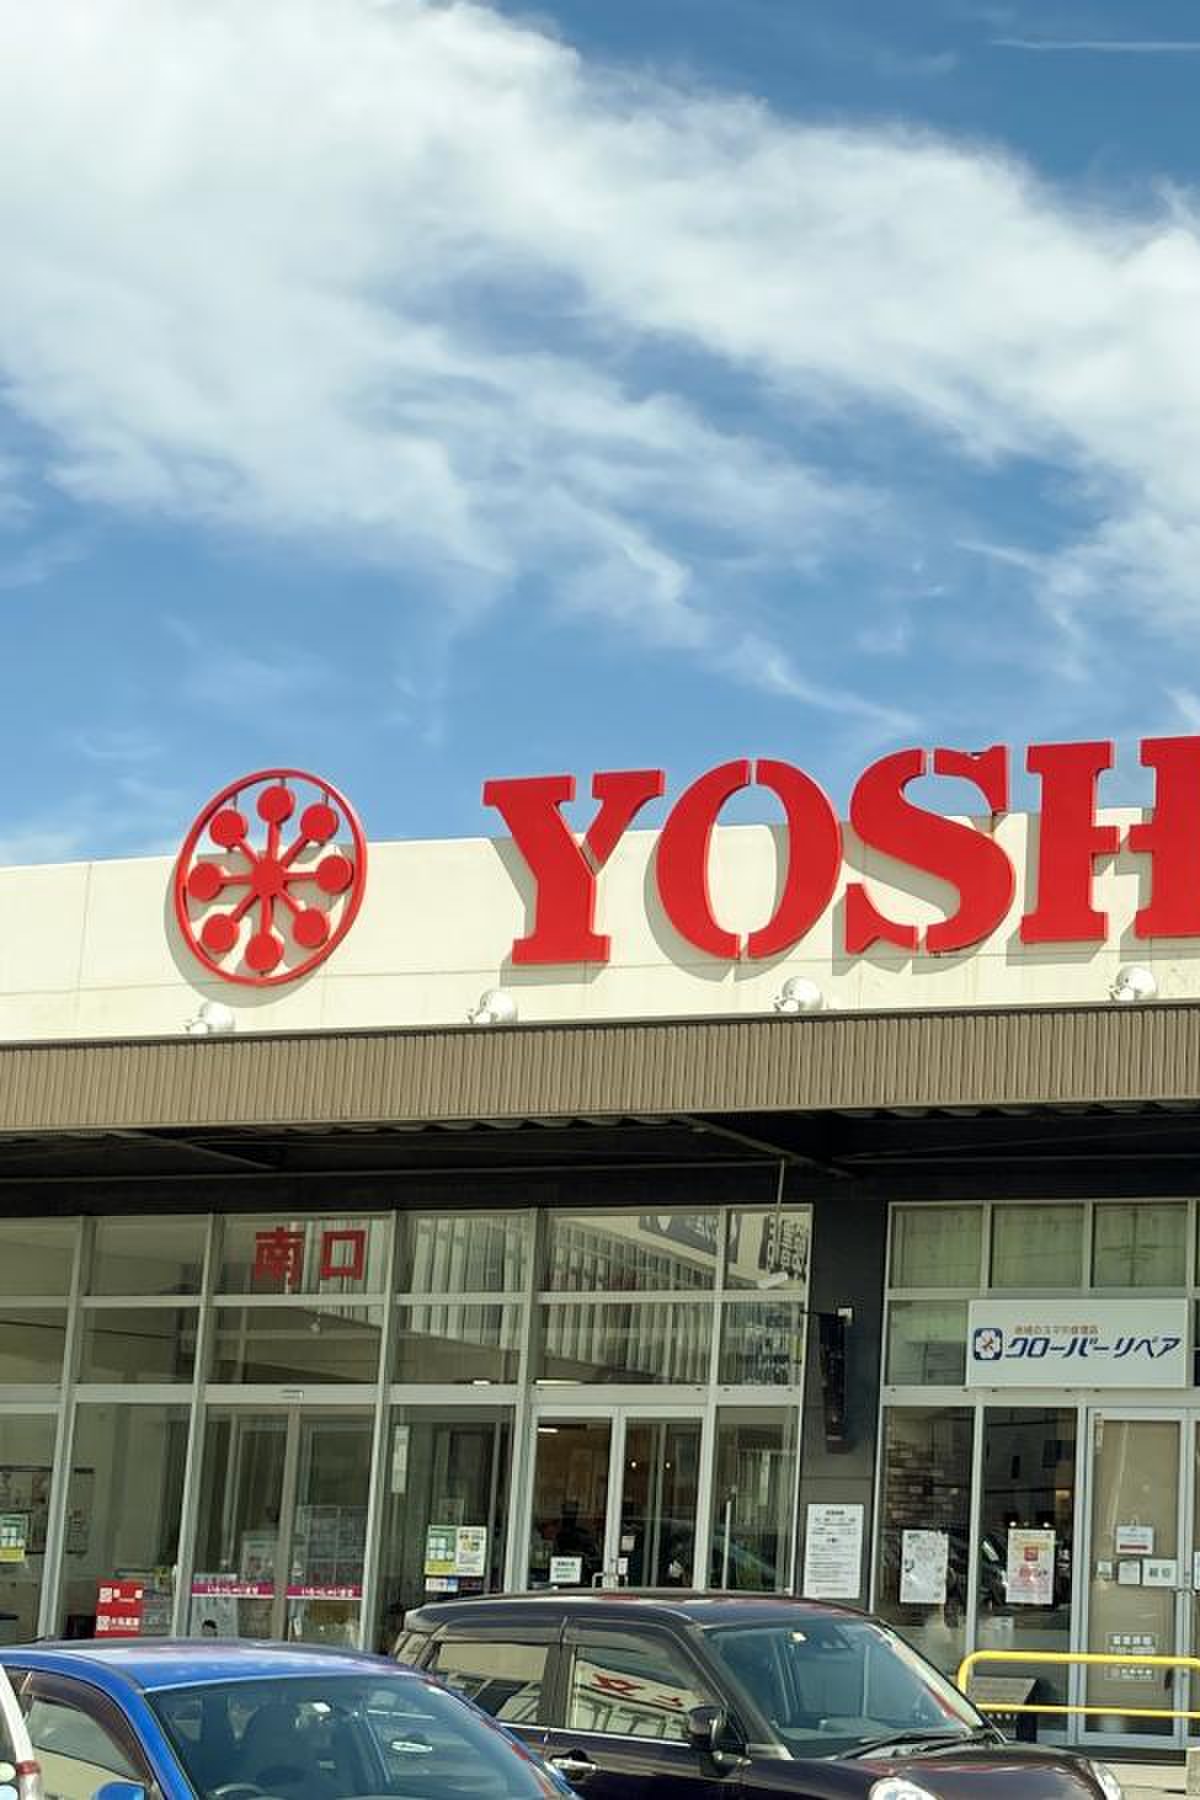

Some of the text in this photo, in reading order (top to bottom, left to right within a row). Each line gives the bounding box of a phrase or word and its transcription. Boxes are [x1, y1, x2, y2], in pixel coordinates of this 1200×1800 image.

[255, 1227, 366, 1283] 南口
[1005, 1337, 1181, 1358] クローバーリペア
